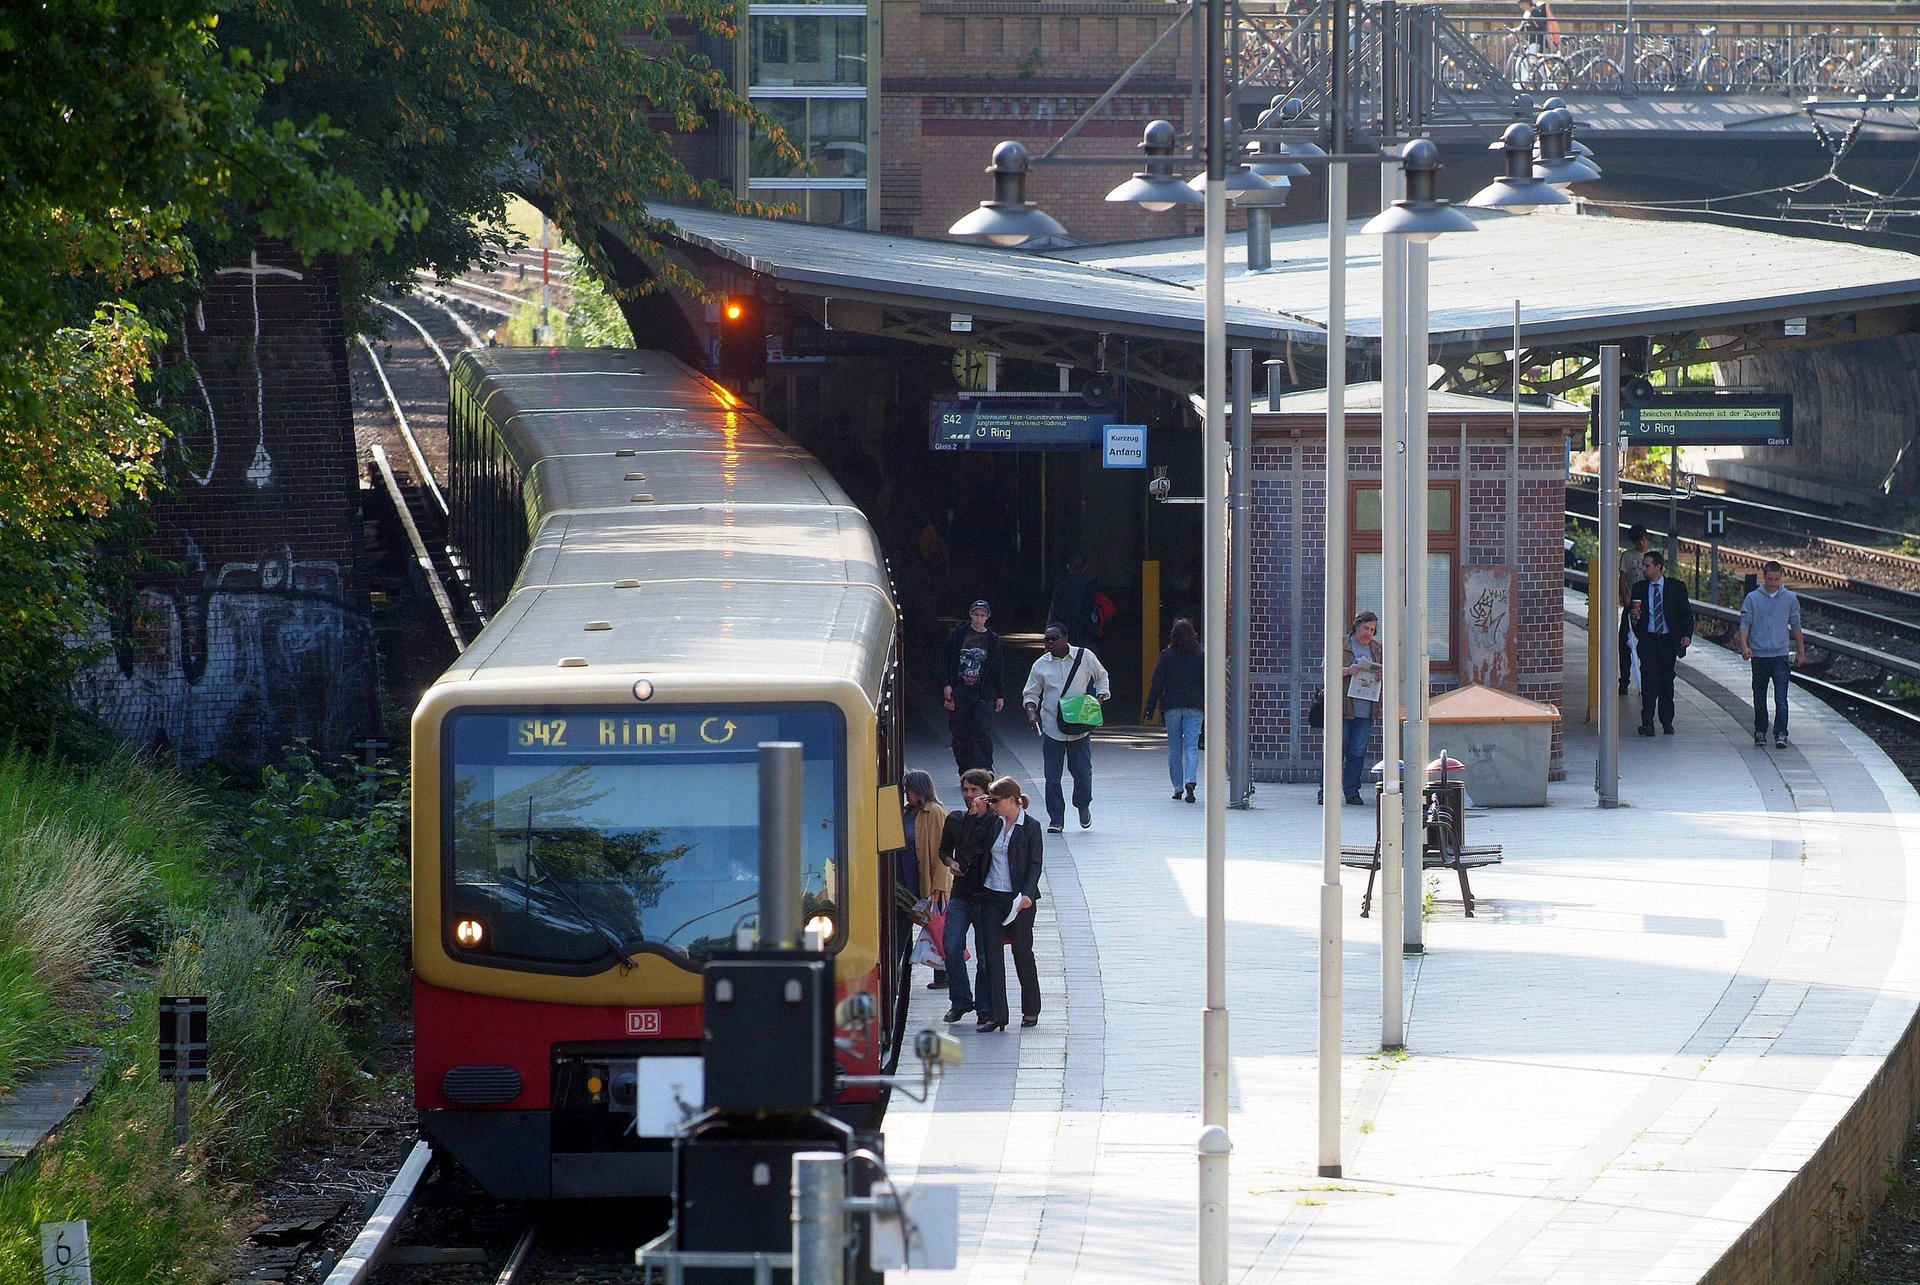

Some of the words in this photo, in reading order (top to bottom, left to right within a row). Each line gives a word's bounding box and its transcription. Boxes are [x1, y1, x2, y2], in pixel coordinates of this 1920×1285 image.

[943, 414, 962, 424] S42
[990, 427, 1011, 439] Ring
[1654, 423, 1675, 435] Ring
[1111, 434, 1139, 443] Kurzzug
[1109, 448, 1142, 458] Anfang
[1707, 510, 1724, 533] H
[518, 719, 567, 745] S42
[599, 719, 676, 745] Ring
[630, 1014, 657, 1030] DB
[56, 1230, 71, 1266] 6
